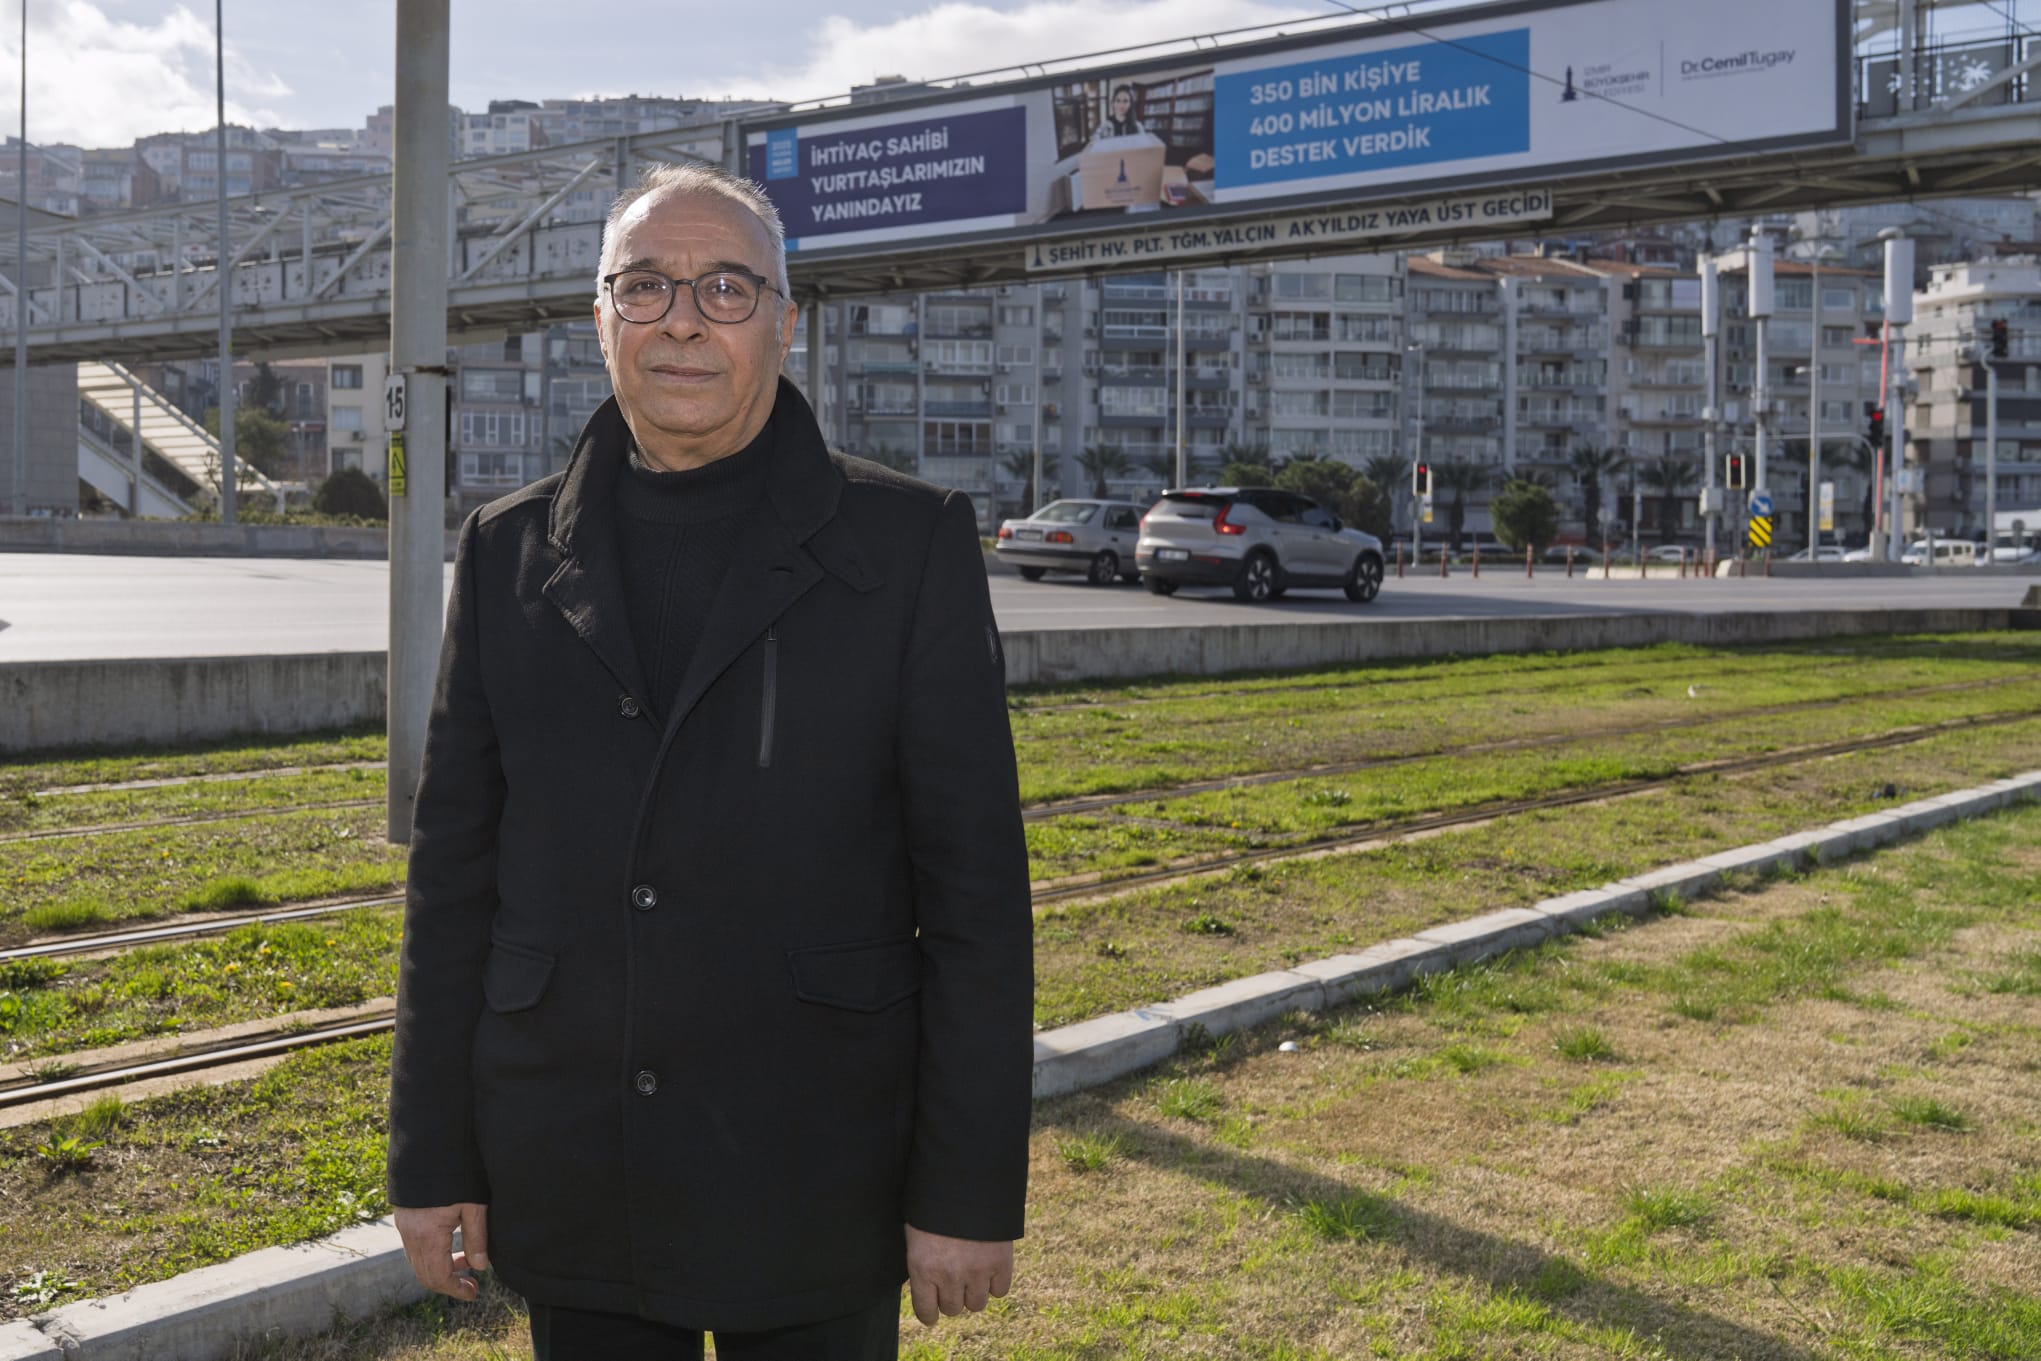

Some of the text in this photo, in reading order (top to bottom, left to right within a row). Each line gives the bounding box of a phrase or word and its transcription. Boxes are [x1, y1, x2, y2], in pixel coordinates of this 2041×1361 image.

[1250, 60, 1421, 105] 350 BİN KİŞİYE
[1249, 85, 1491, 136] 400 MİLYON LİRALIK
[811, 140, 882, 167] İHTİYAÇ
[886, 126, 949, 157] SAHİBİ
[1250, 124, 1431, 170] DESTEK VERDİK
[811, 156, 985, 195] YURTTAŞLARIMIZIN
[811, 193, 923, 223] YANINDAYIZ
[1050, 239, 1096, 265] ŞEHİT
[1101, 240, 1126, 257] HV.
[1134, 237, 1164, 254] PLT.
[1386, 206, 1431, 227] YAYA
[1483, 189, 1549, 217] GEÇİDİ
